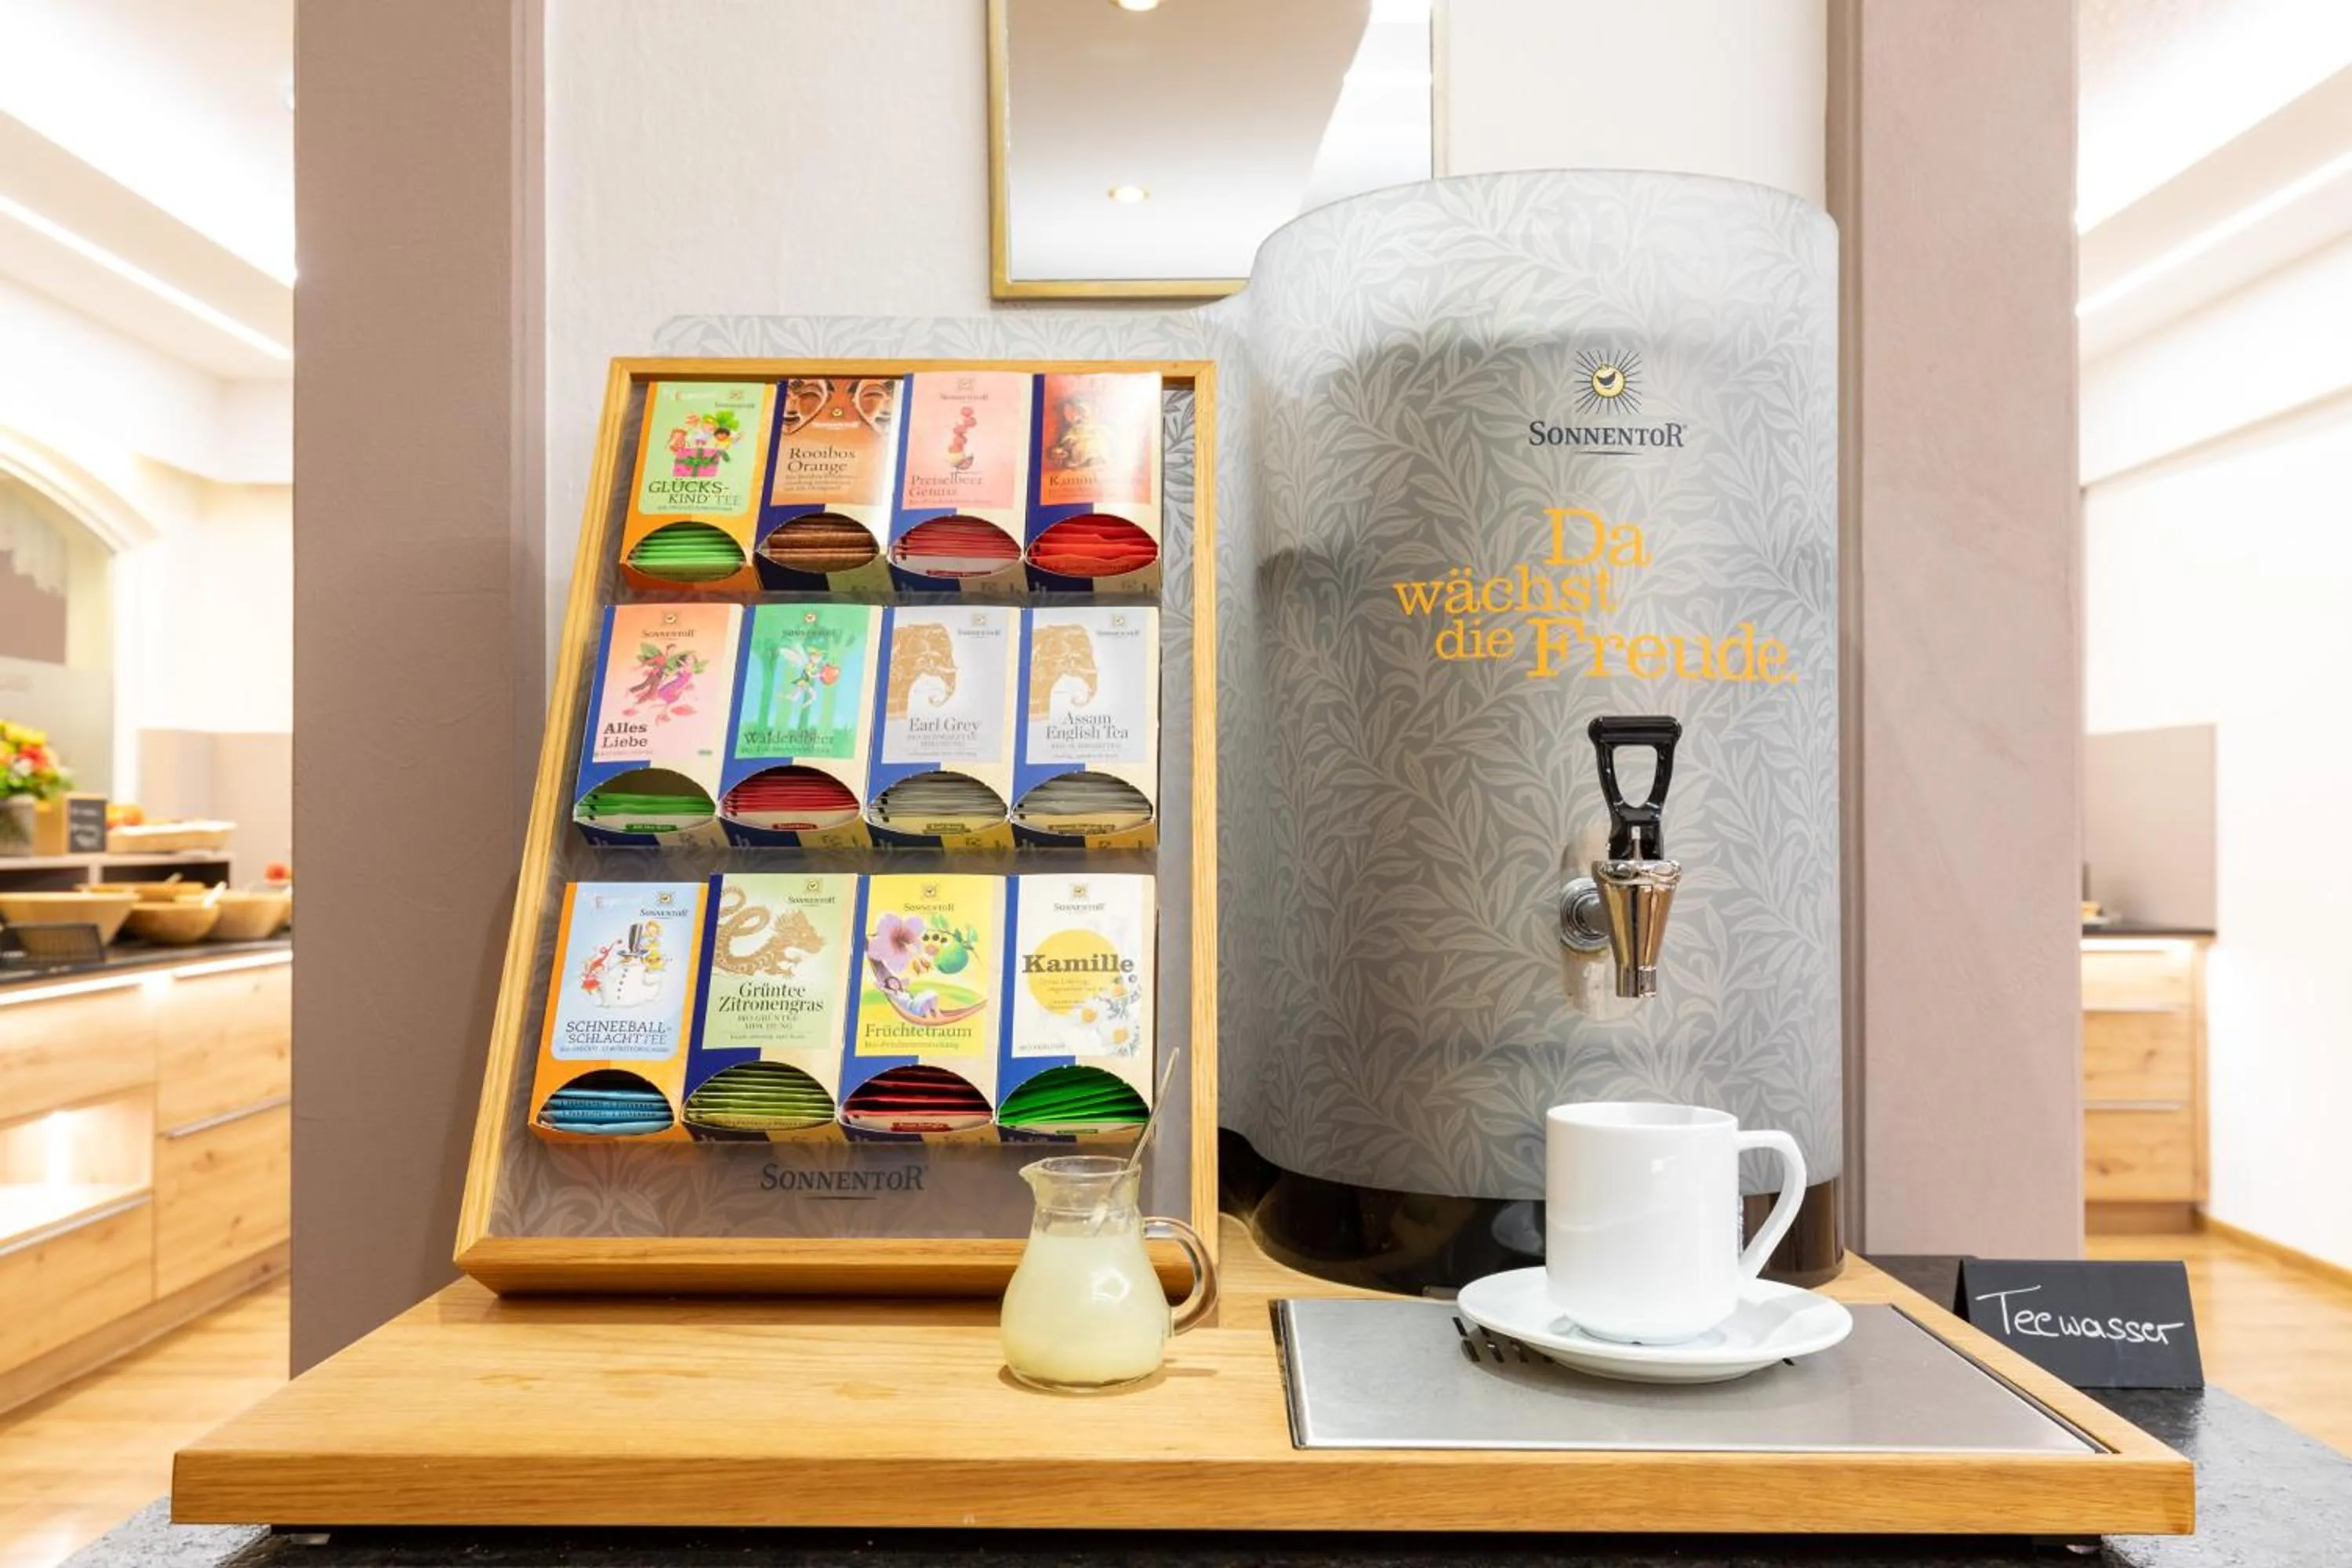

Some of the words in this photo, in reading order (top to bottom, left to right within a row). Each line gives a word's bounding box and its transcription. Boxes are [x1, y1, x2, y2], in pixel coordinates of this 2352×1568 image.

[1528, 420, 1686, 448] SONNENTOR
[789, 445, 856, 459] Rooibos
[786, 460, 848, 475] Orange
[648, 478, 730, 494] GLÜCKS-
[668, 493, 710, 504] KIND
[1543, 506, 1652, 569] Da
[1392, 564, 1618, 615] wächst
[1435, 619, 1516, 661] die
[1526, 615, 1800, 684] Freude.
[908, 717, 940, 732] Earl
[943, 717, 981, 736] Grey
[1062, 711, 1112, 725] Assam
[603, 721, 648, 735] Alles
[1045, 725, 1100, 742] English
[1103, 724, 1129, 739] Tea
[601, 735, 648, 749] Liebe
[1021, 953, 1135, 973] Kamille
[739, 981, 807, 998] Grüntee
[718, 996, 825, 1015] Zitronengras
[565, 1020, 673, 1034] SCHNEEBALL-
[865, 1022, 972, 1038] Früchtetraum
[760, 1163, 926, 1191] SONNENTOR
[1975, 1284, 2185, 1346] Teewasser
